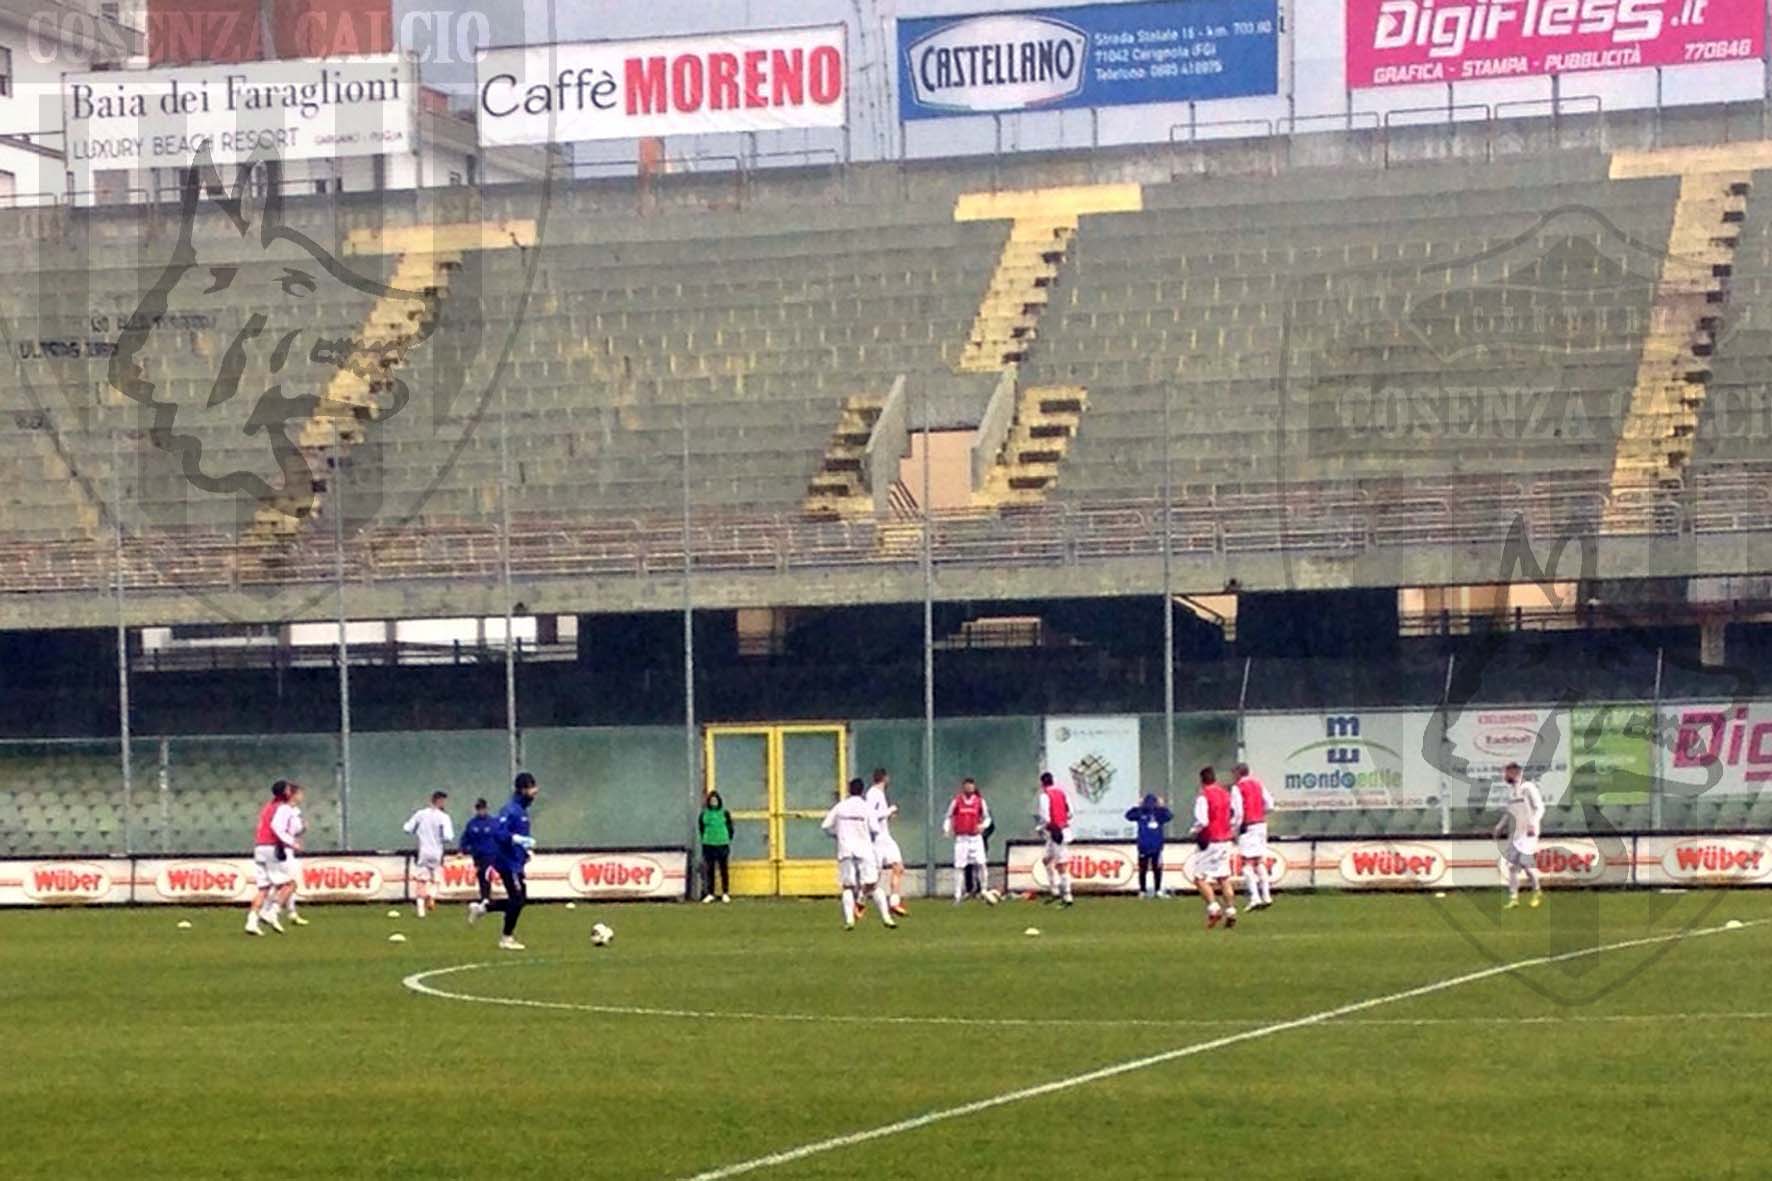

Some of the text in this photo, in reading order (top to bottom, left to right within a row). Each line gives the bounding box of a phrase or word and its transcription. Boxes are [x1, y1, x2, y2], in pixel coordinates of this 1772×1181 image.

[921, 39, 1075, 92] CASTELLANO
[1373, 62, 1444, 84] GRAFICA
[1461, 56, 1529, 77] STAMPA
[1544, 43, 1642, 71] PUBBLICITÀ
[71, 66, 402, 120] Baia dei Faraglioni
[481, 45, 842, 117] Caffè MORENO
[73, 127, 299, 160] LUXURY BEACH RESORT
[1353, 850, 1437, 876] Wüber
[1677, 846, 1765, 871] Wüber
[34, 869, 103, 893] Wüber
[168, 868, 238, 892] Wüber
[303, 868, 375, 891] Wüber
[581, 862, 655, 887] Wüber
